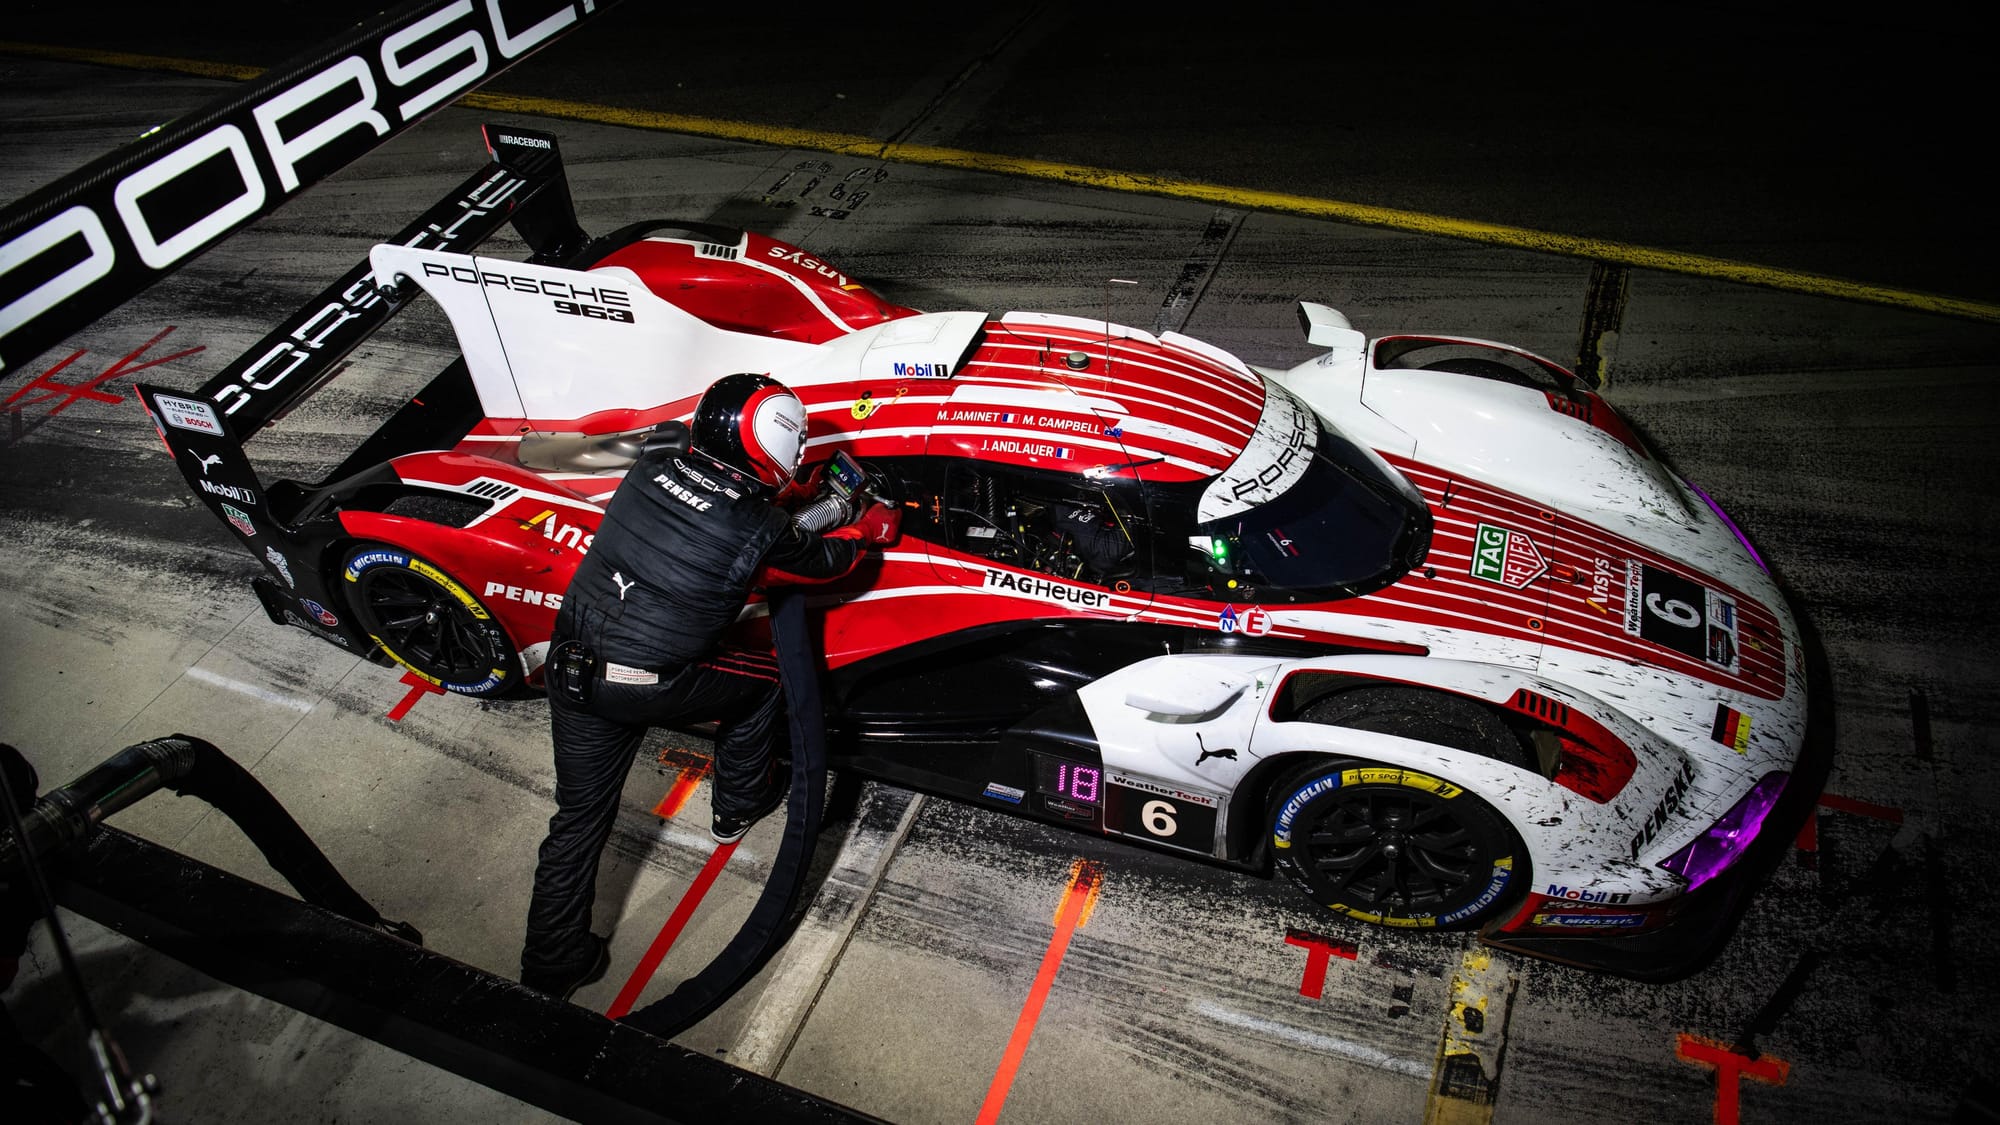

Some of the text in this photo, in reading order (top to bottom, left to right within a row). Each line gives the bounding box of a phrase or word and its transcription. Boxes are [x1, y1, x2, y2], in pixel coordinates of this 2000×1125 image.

[508, 135, 551, 150] RACEBORN
[422, 262, 631, 308] PORSCHE
[768, 246, 864, 291] Ansys
[554, 300, 636, 324] 963
[894, 362, 933, 377] Mobil
[185, 417, 213, 429] BOSCH
[936, 410, 1101, 435] M. JAMINET M. CAMPBELL
[981, 440, 1054, 457] J. ANDLAUER
[1232, 396, 1305, 501] PORSC
[200, 479, 241, 500] Mobil
[653, 474, 713, 512] PENSKE
[354, 554, 404, 571] MICHELIN
[1477, 530, 1505, 574] TAG
[1505, 534, 1542, 584] HEUER
[1586, 557, 1614, 614] Ansys
[1628, 563, 1642, 632] WeatherTech
[1222, 619, 1233, 631] N
[1246, 612, 1265, 634] E
[1645, 592, 1701, 629] 6
[1058, 764, 1099, 802] 18
[1113, 775, 1212, 805] WeatherTech
[1349, 772, 1411, 783] PILOT SPORT
[1141, 800, 1178, 837] 6
[1280, 777, 1333, 830] MICHELIN
[1630, 757, 1696, 862] PENSKE
[1445, 877, 1504, 923] MICHELIN
[1547, 884, 1608, 904] Mobil
